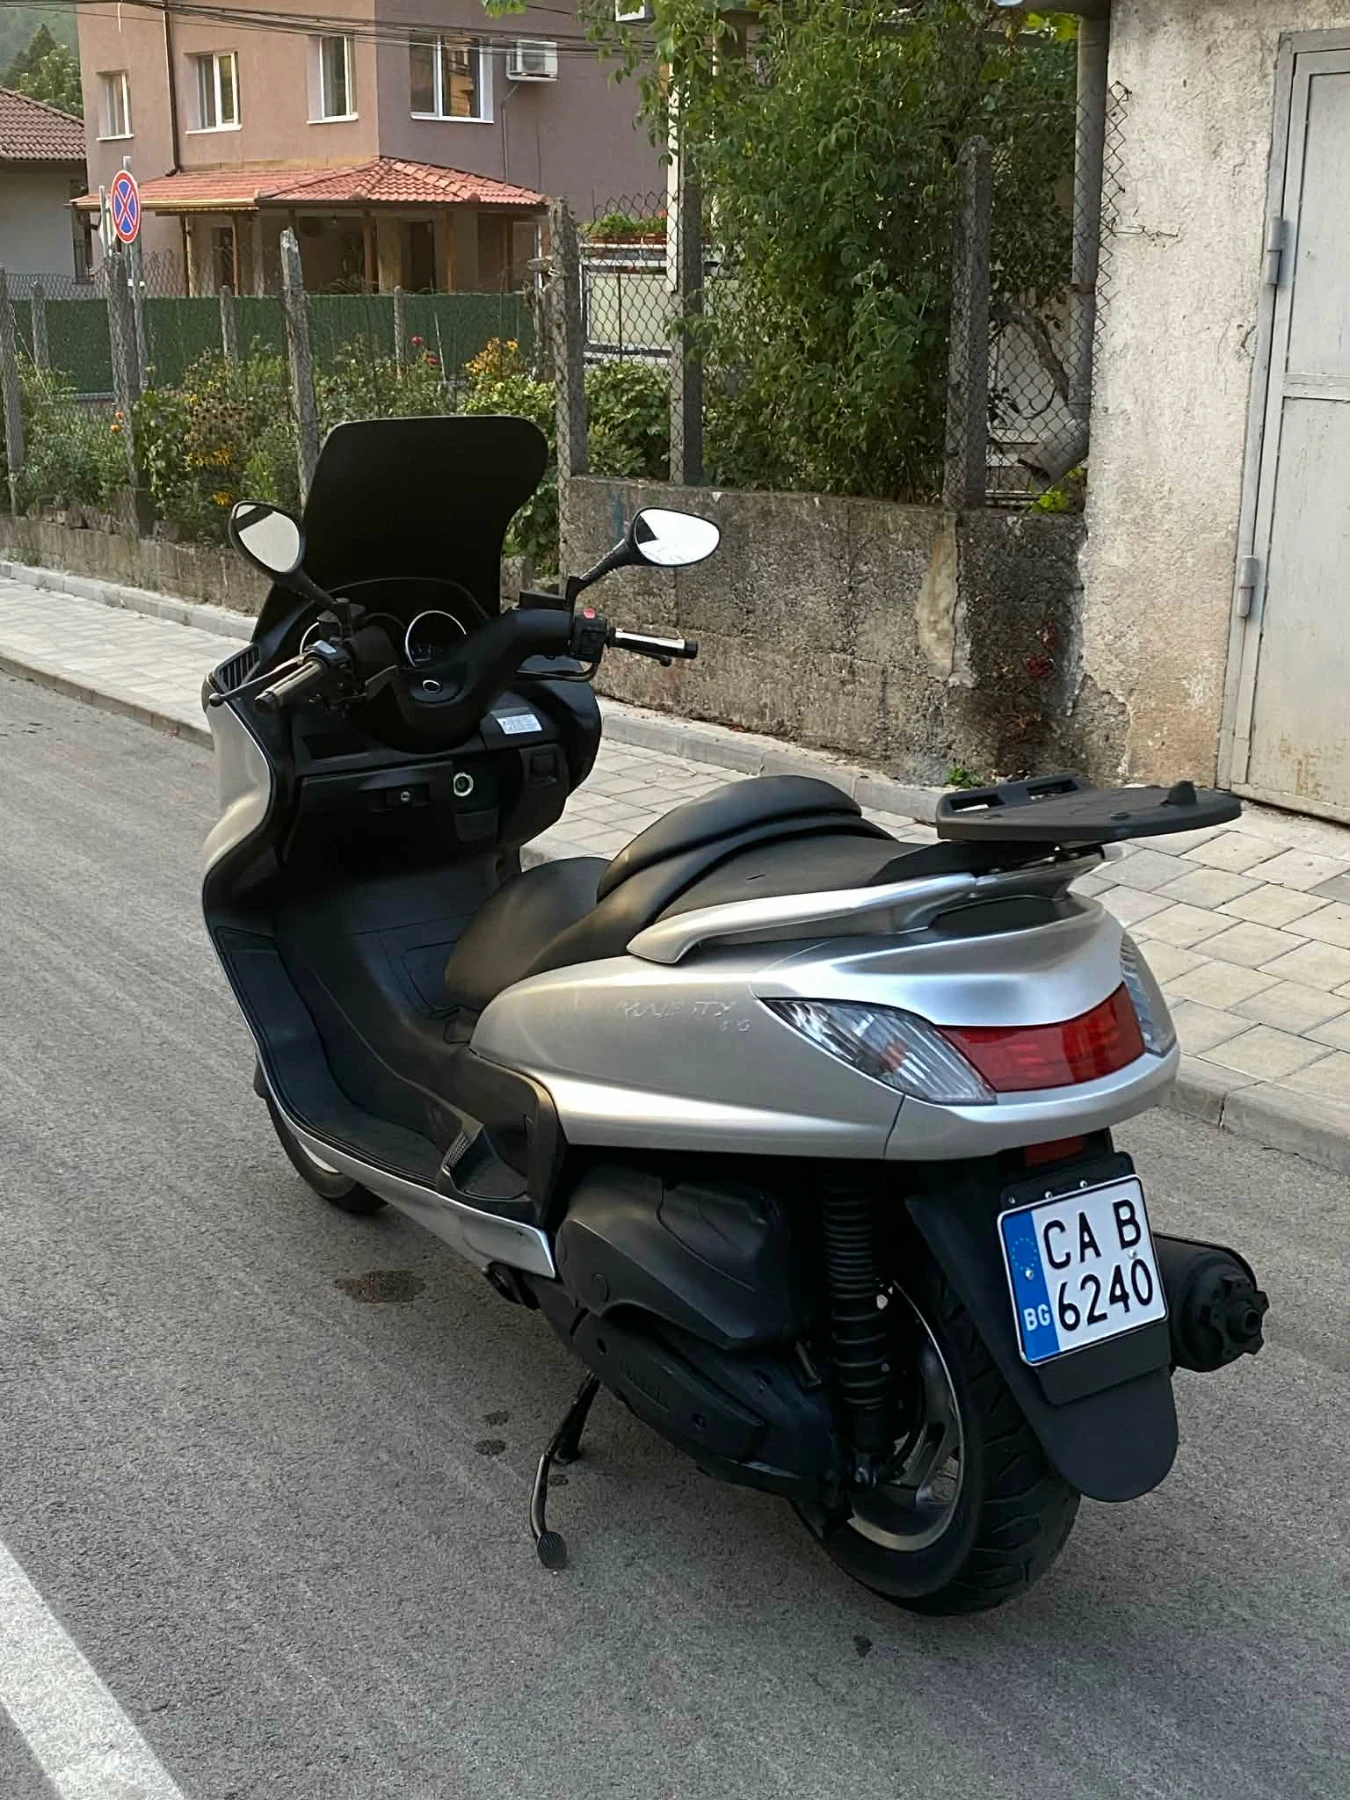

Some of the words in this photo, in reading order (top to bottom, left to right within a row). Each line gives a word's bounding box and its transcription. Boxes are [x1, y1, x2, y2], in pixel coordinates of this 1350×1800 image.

[1043, 1212, 1101, 1270] CA
[1112, 1199, 1142, 1250] B
[1023, 1304, 1051, 1331] BG
[1057, 1258, 1153, 1332] 6240
